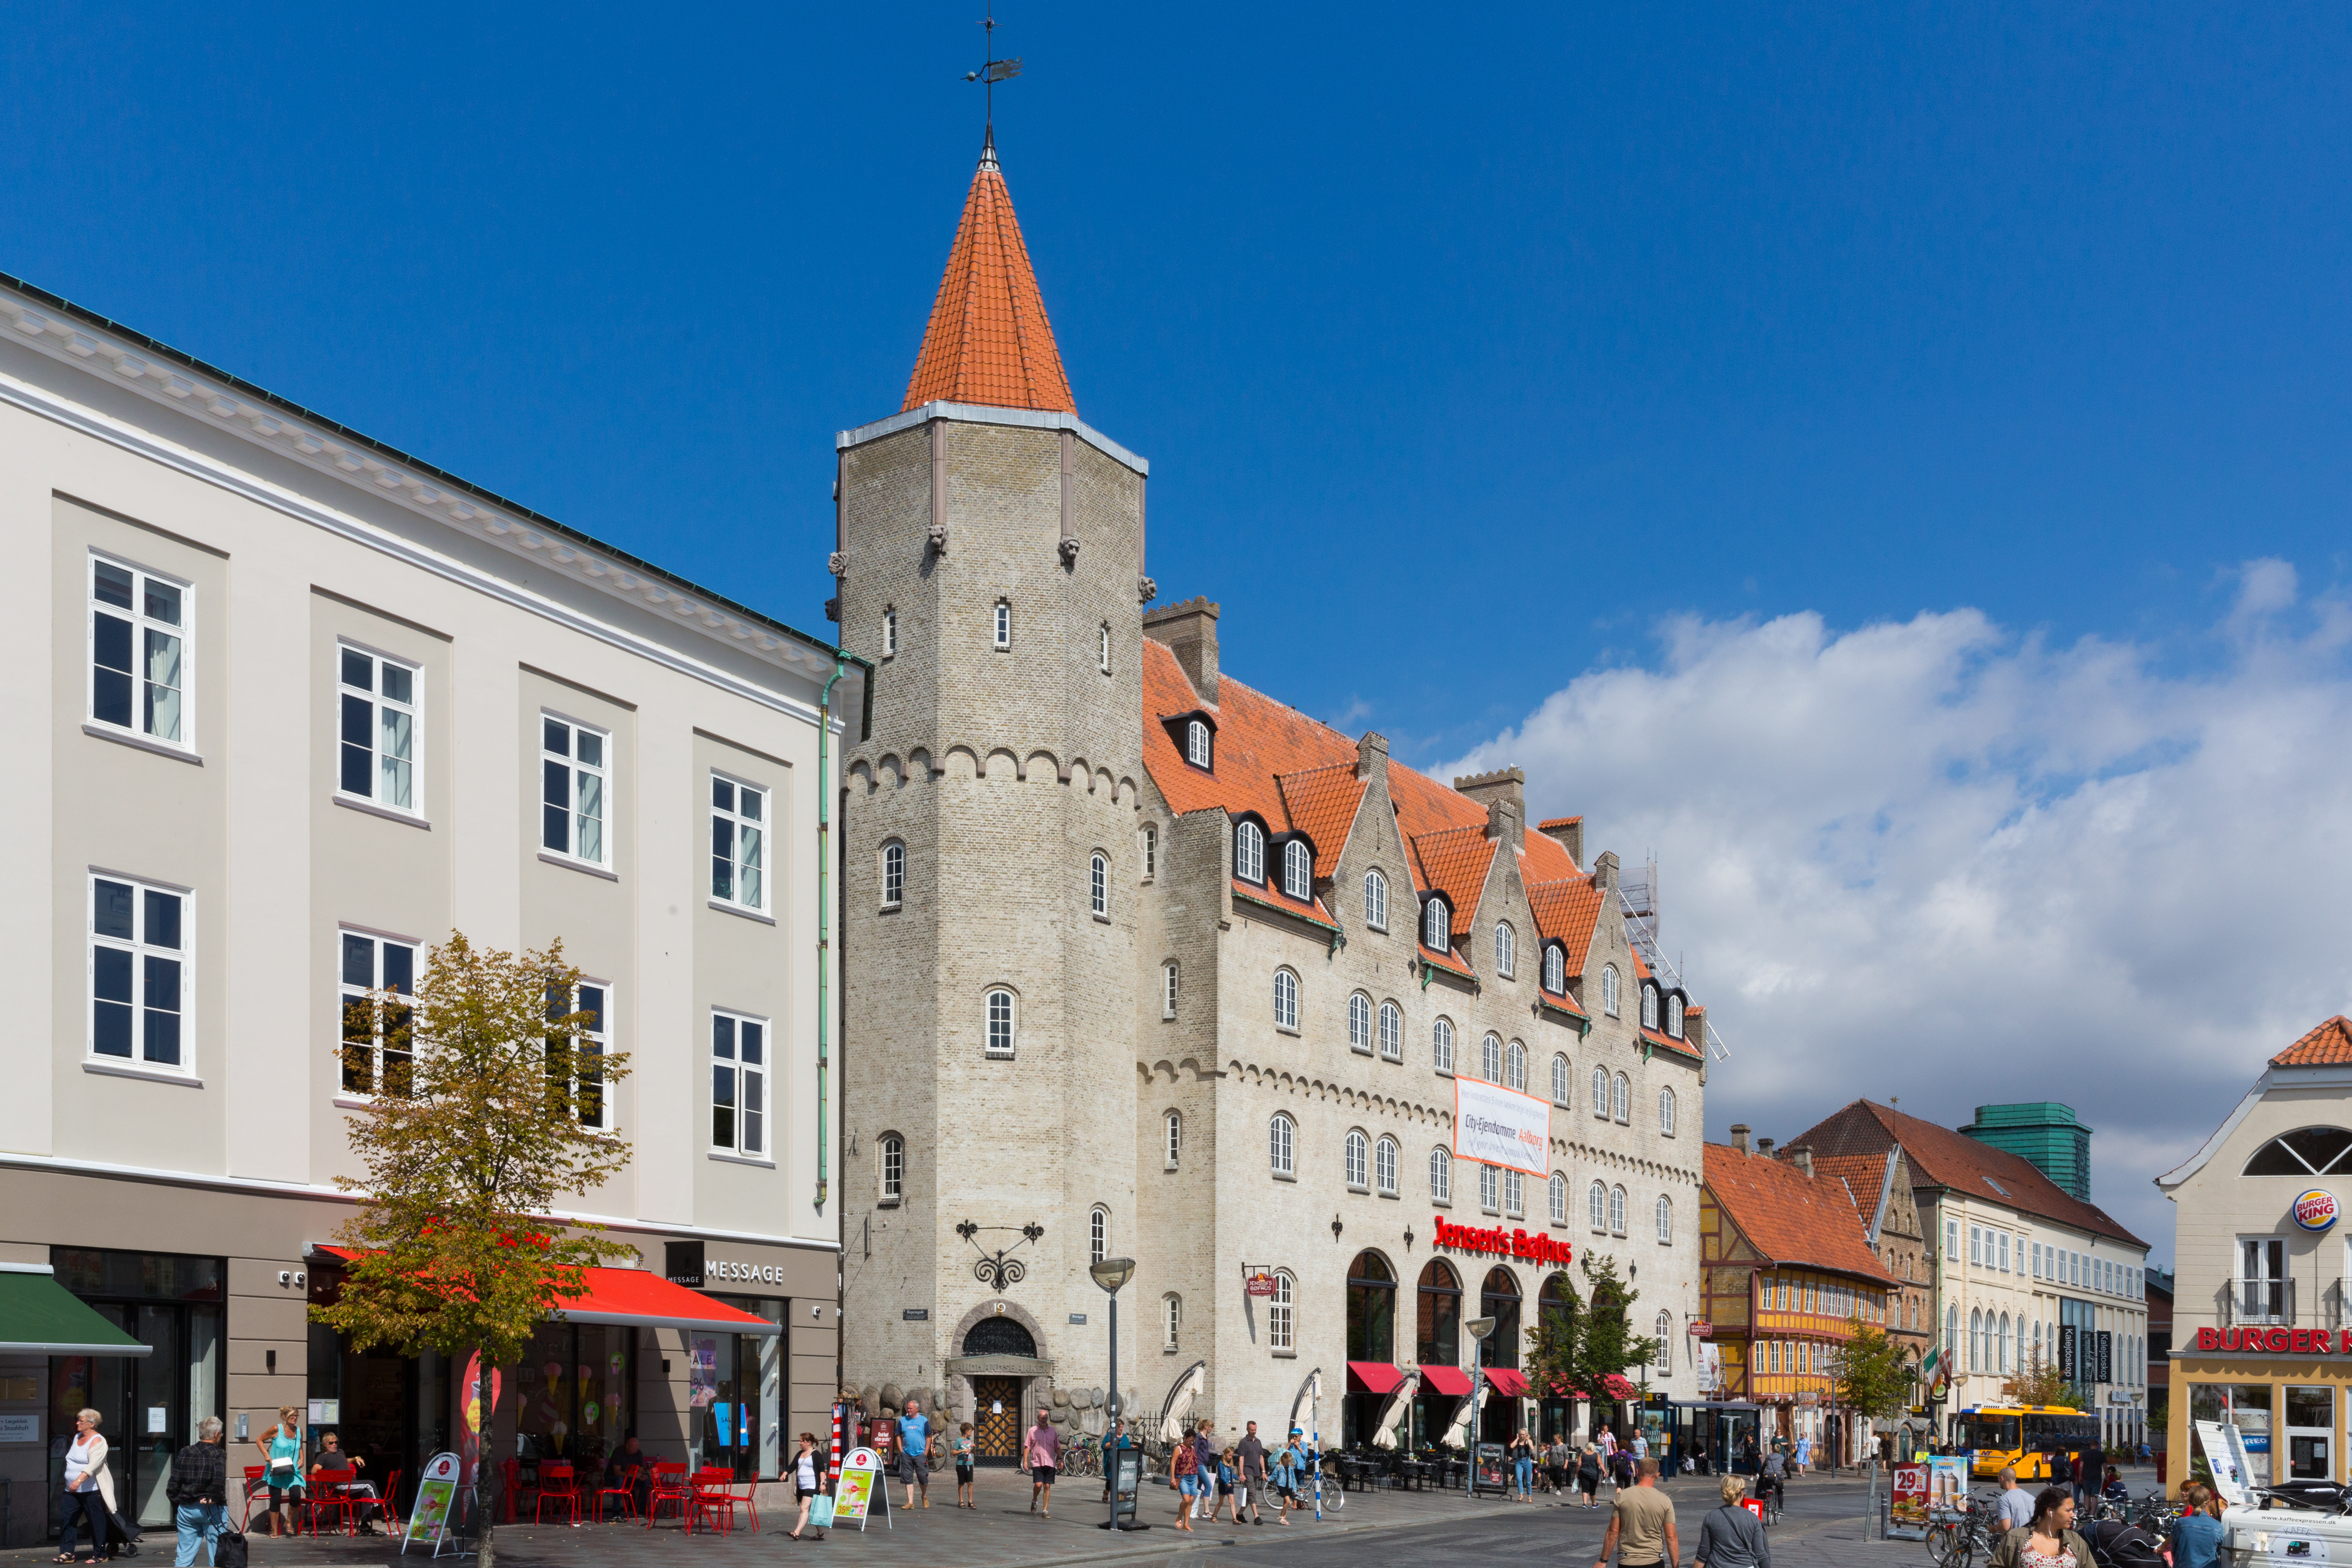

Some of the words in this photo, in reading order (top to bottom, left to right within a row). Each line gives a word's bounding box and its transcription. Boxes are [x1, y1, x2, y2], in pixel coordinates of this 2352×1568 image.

[1461, 1089, 1470, 1098] Her
[1471, 1091, 1491, 1103] indrettes
[1491, 1096, 1494, 1104] 9
[1495, 1099, 1503, 1108] nye
[1503, 1099, 1516, 1111] lækre
[1516, 1103, 1524, 1115] leje
[1525, 1106, 1547, 1121] lejligheder
[1466, 1114, 1516, 1139] City-Ejendomme
[1518, 1128, 1543, 1151] Aalborg
[1476, 1139, 1488, 1151] gør
[2297, 1197, 2332, 1212] BURGER
[2299, 1203, 2334, 1223] KING
[1434, 1215, 1510, 1254] Jensen's
[1512, 1228, 1572, 1266] Bøfhus
[705, 1260, 783, 1282] MESSAGE
[993, 1303, 1006, 1313] 19
[2197, 1327, 2332, 1353] BURGER
[690, 1354, 712, 1365] ALE
[2063, 1329, 2073, 1377] Kalejdoskop
[2099, 1334, 2108, 1380] Kalejdoskop
[1122, 1459, 1136, 1469] Jensens
[1121, 1471, 1134, 1481] Bøfhus
[1898, 1471, 1916, 1489] 29
[2261, 1515, 2336, 1525] www.kaffeexpressen.dk
[2283, 1526, 2312, 1537] KAFFE
